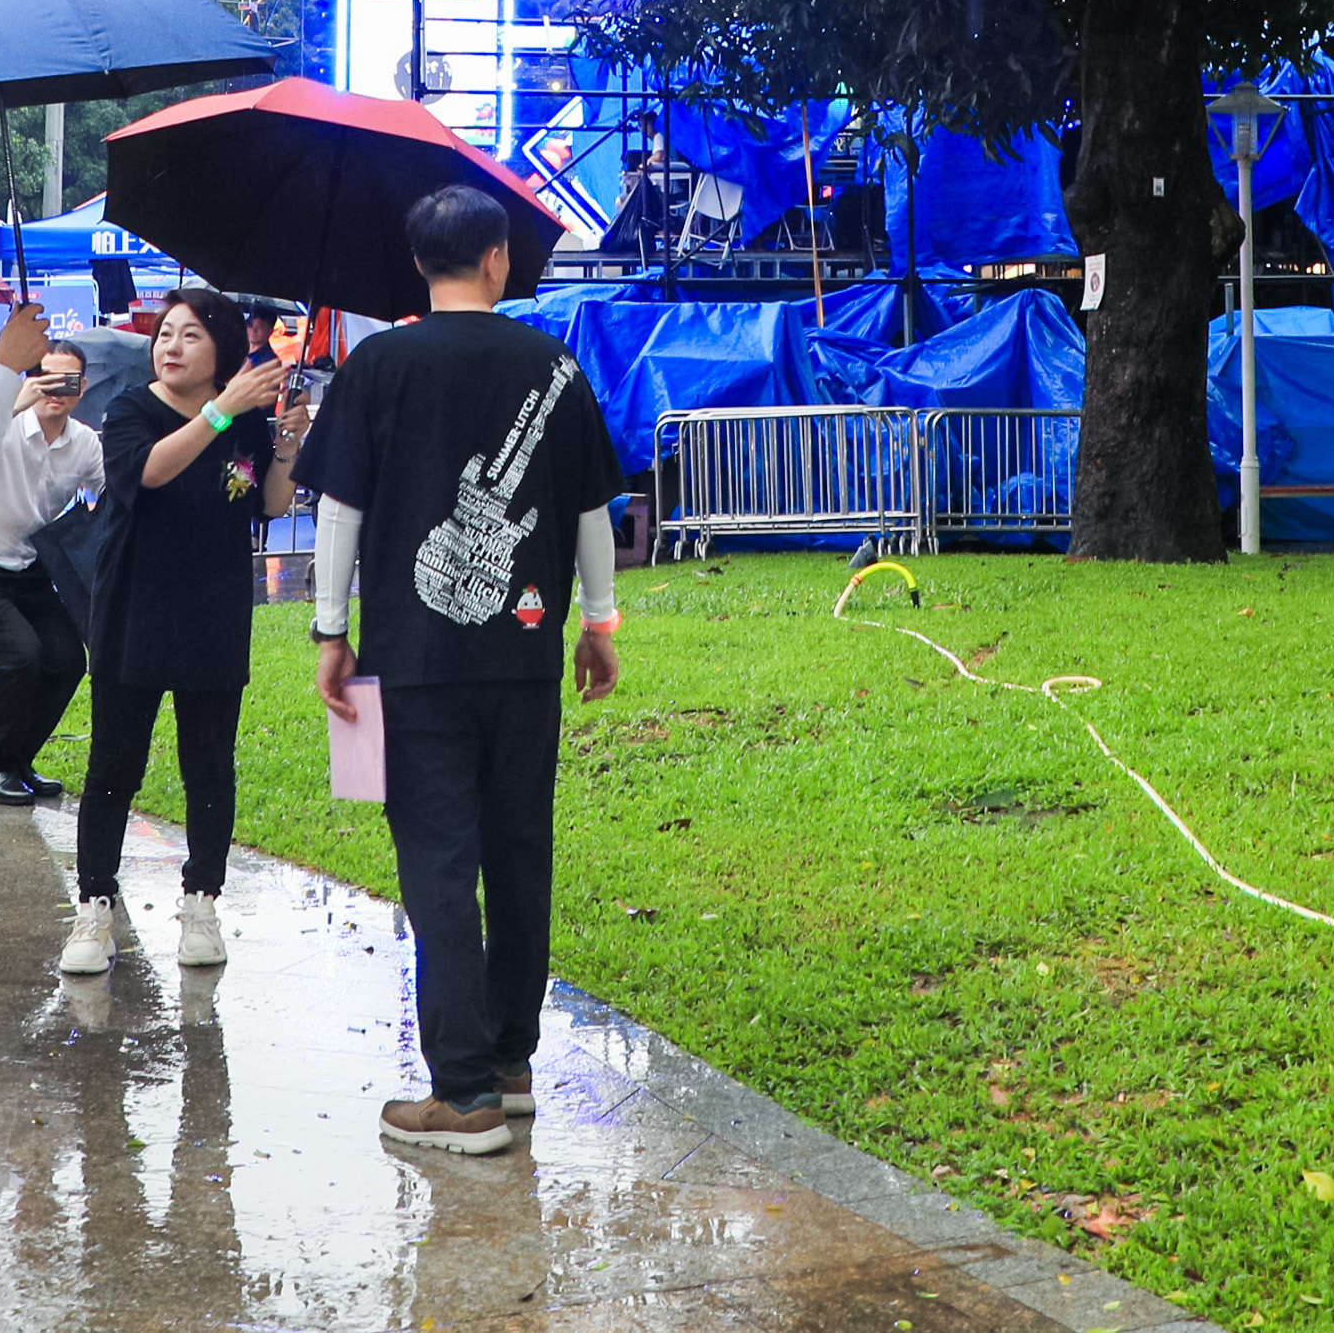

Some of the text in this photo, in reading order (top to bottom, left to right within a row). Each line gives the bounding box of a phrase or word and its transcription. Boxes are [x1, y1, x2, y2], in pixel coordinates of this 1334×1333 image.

[426, 529, 474, 562] SUMMER
[471, 555, 513, 583] LITCHI
[461, 524, 514, 559] SUMMER
[470, 541, 514, 572] LITCHI
[414, 548, 469, 584] summer
[466, 574, 508, 606] litchi
